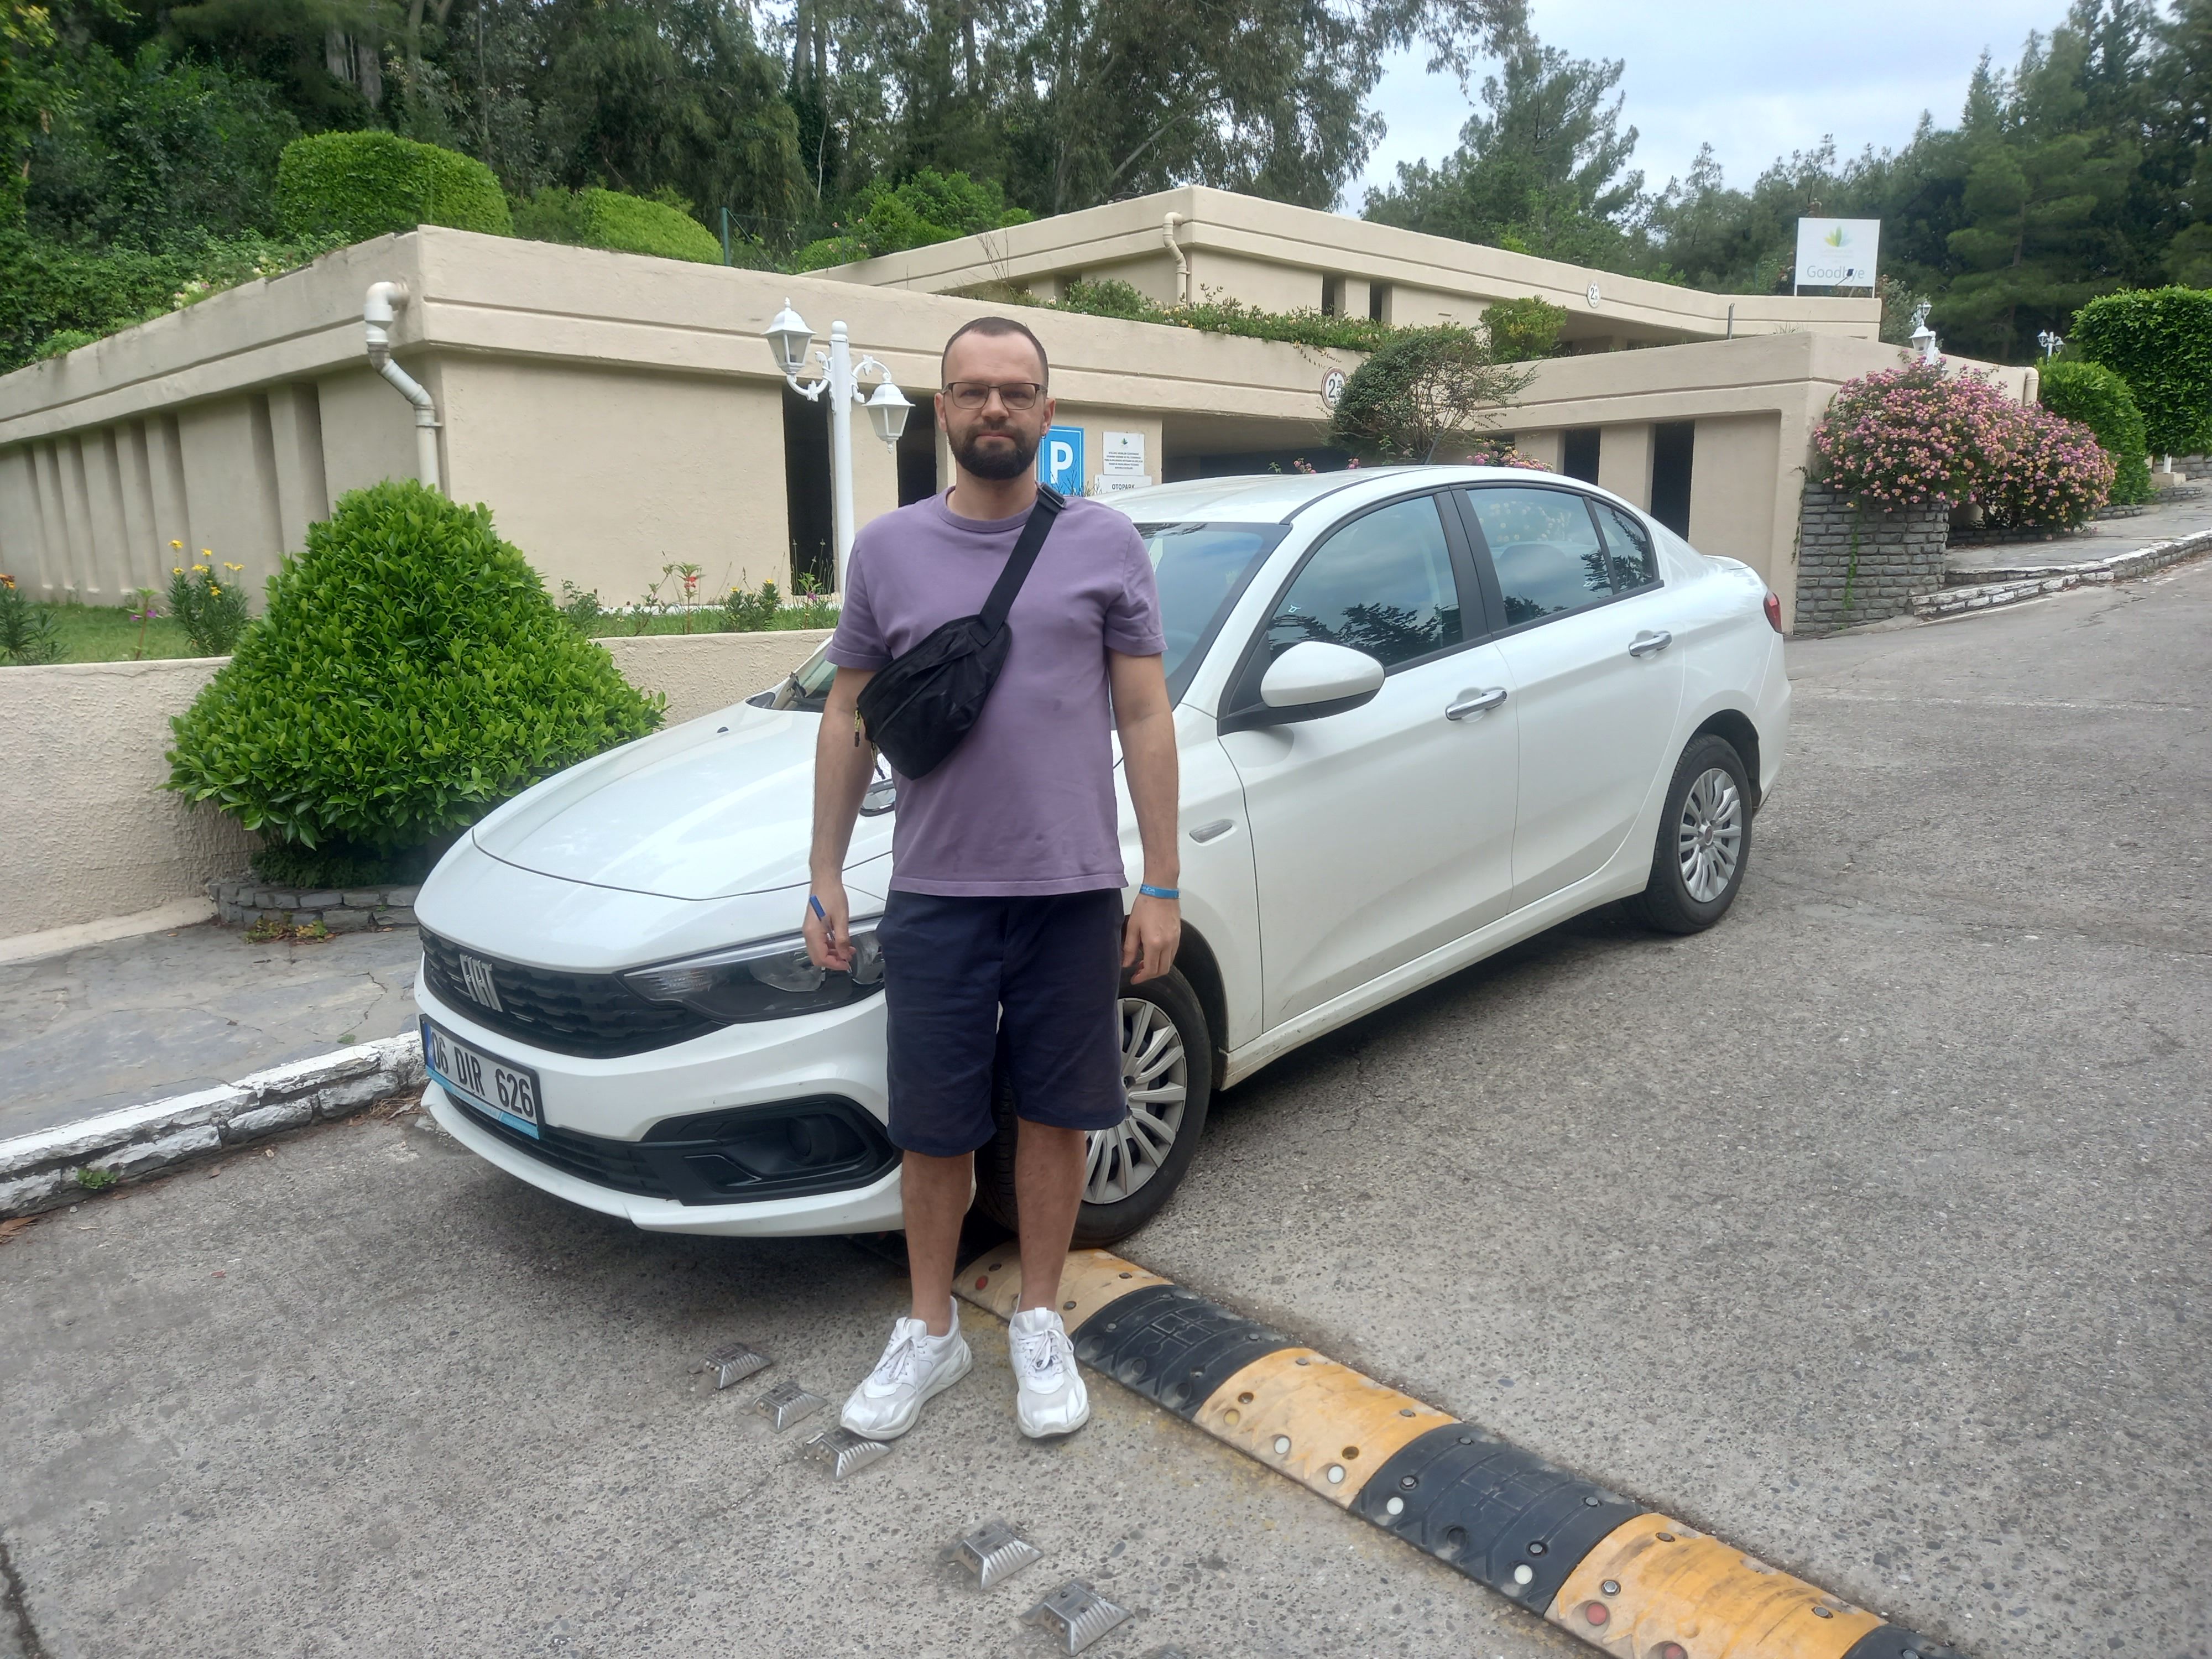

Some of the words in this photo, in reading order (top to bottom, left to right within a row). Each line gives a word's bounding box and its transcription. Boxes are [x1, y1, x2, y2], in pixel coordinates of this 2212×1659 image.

[1590, 287, 1594, 299] 2
[1328, 379, 1335, 398] 2
[1050, 441, 1073, 484] P
[460, 953, 503, 1013] FIAT
[431, 1032, 448, 1074] 06
[454, 1046, 486, 1096] DIR
[495, 1068, 534, 1118] 626
